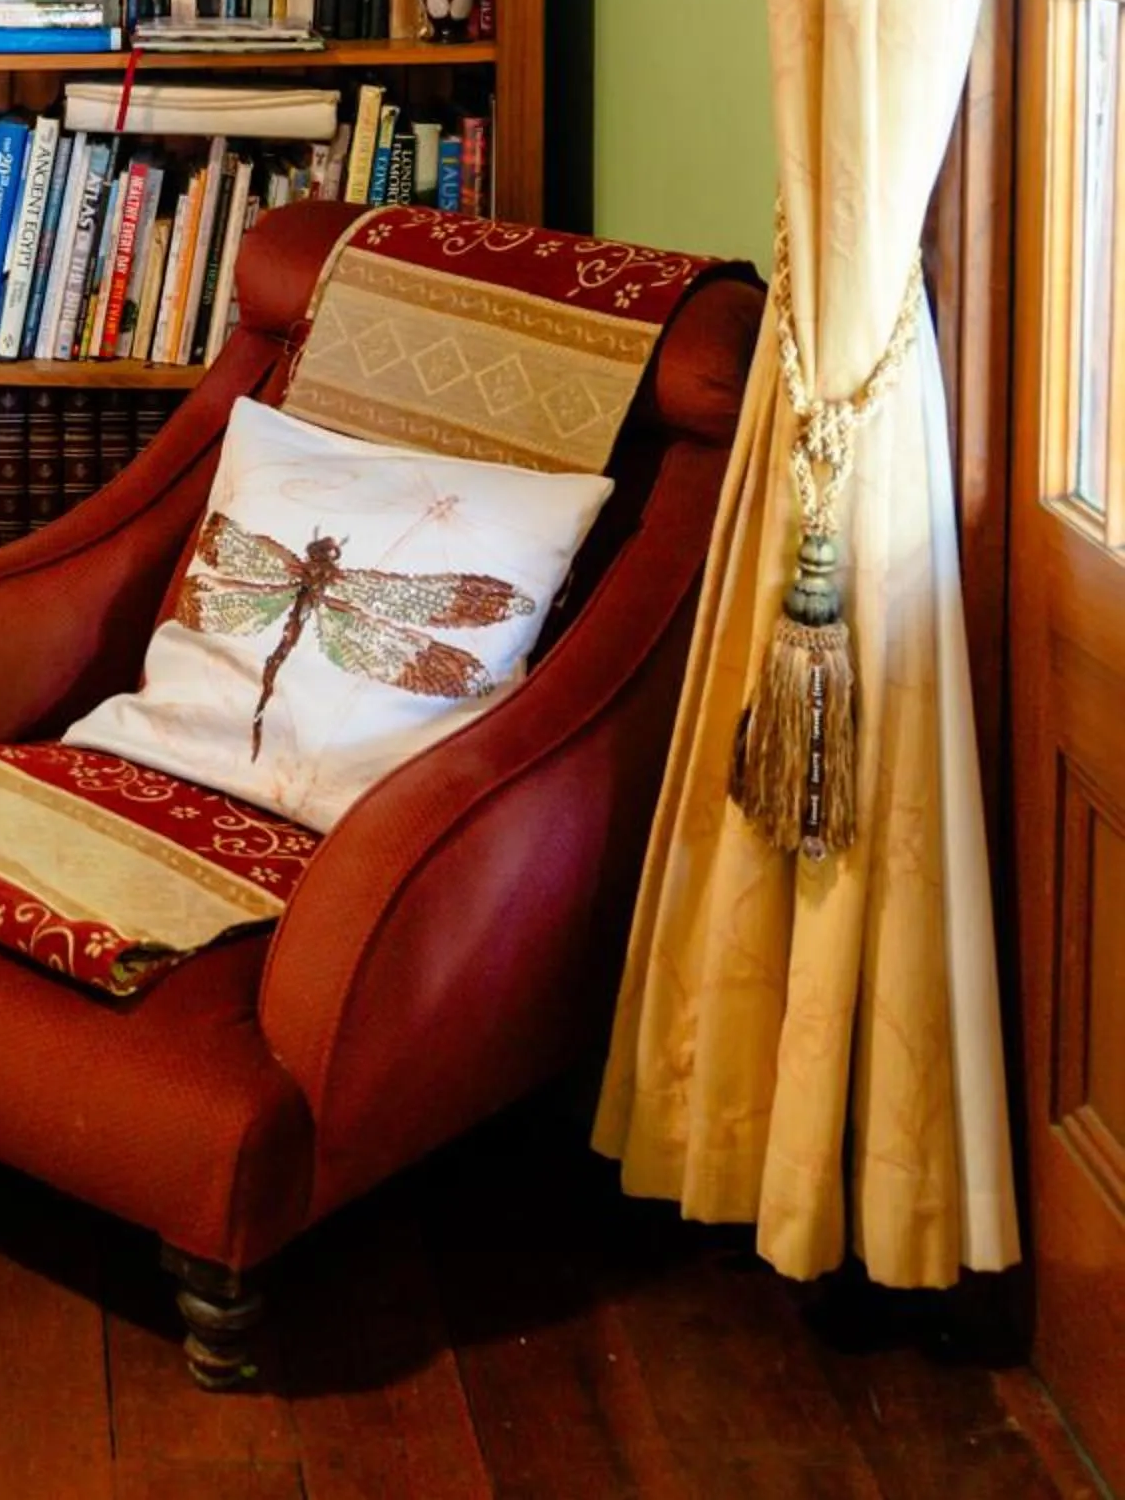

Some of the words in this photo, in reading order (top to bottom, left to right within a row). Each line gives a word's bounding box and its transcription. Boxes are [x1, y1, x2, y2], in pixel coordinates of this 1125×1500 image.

[26, 146, 51, 215] ANCIENT
[123, 174, 143, 219] HEALTHY
[386, 142, 401, 203] IMMORT
[399, 150, 412, 205] LONDO
[441, 166, 458, 210] AUS
[78, 171, 101, 230] ATLAS
[16, 219, 37, 270] EGYPT
[117, 221, 135, 254] EVERY
[114, 255, 128, 274] DAY
